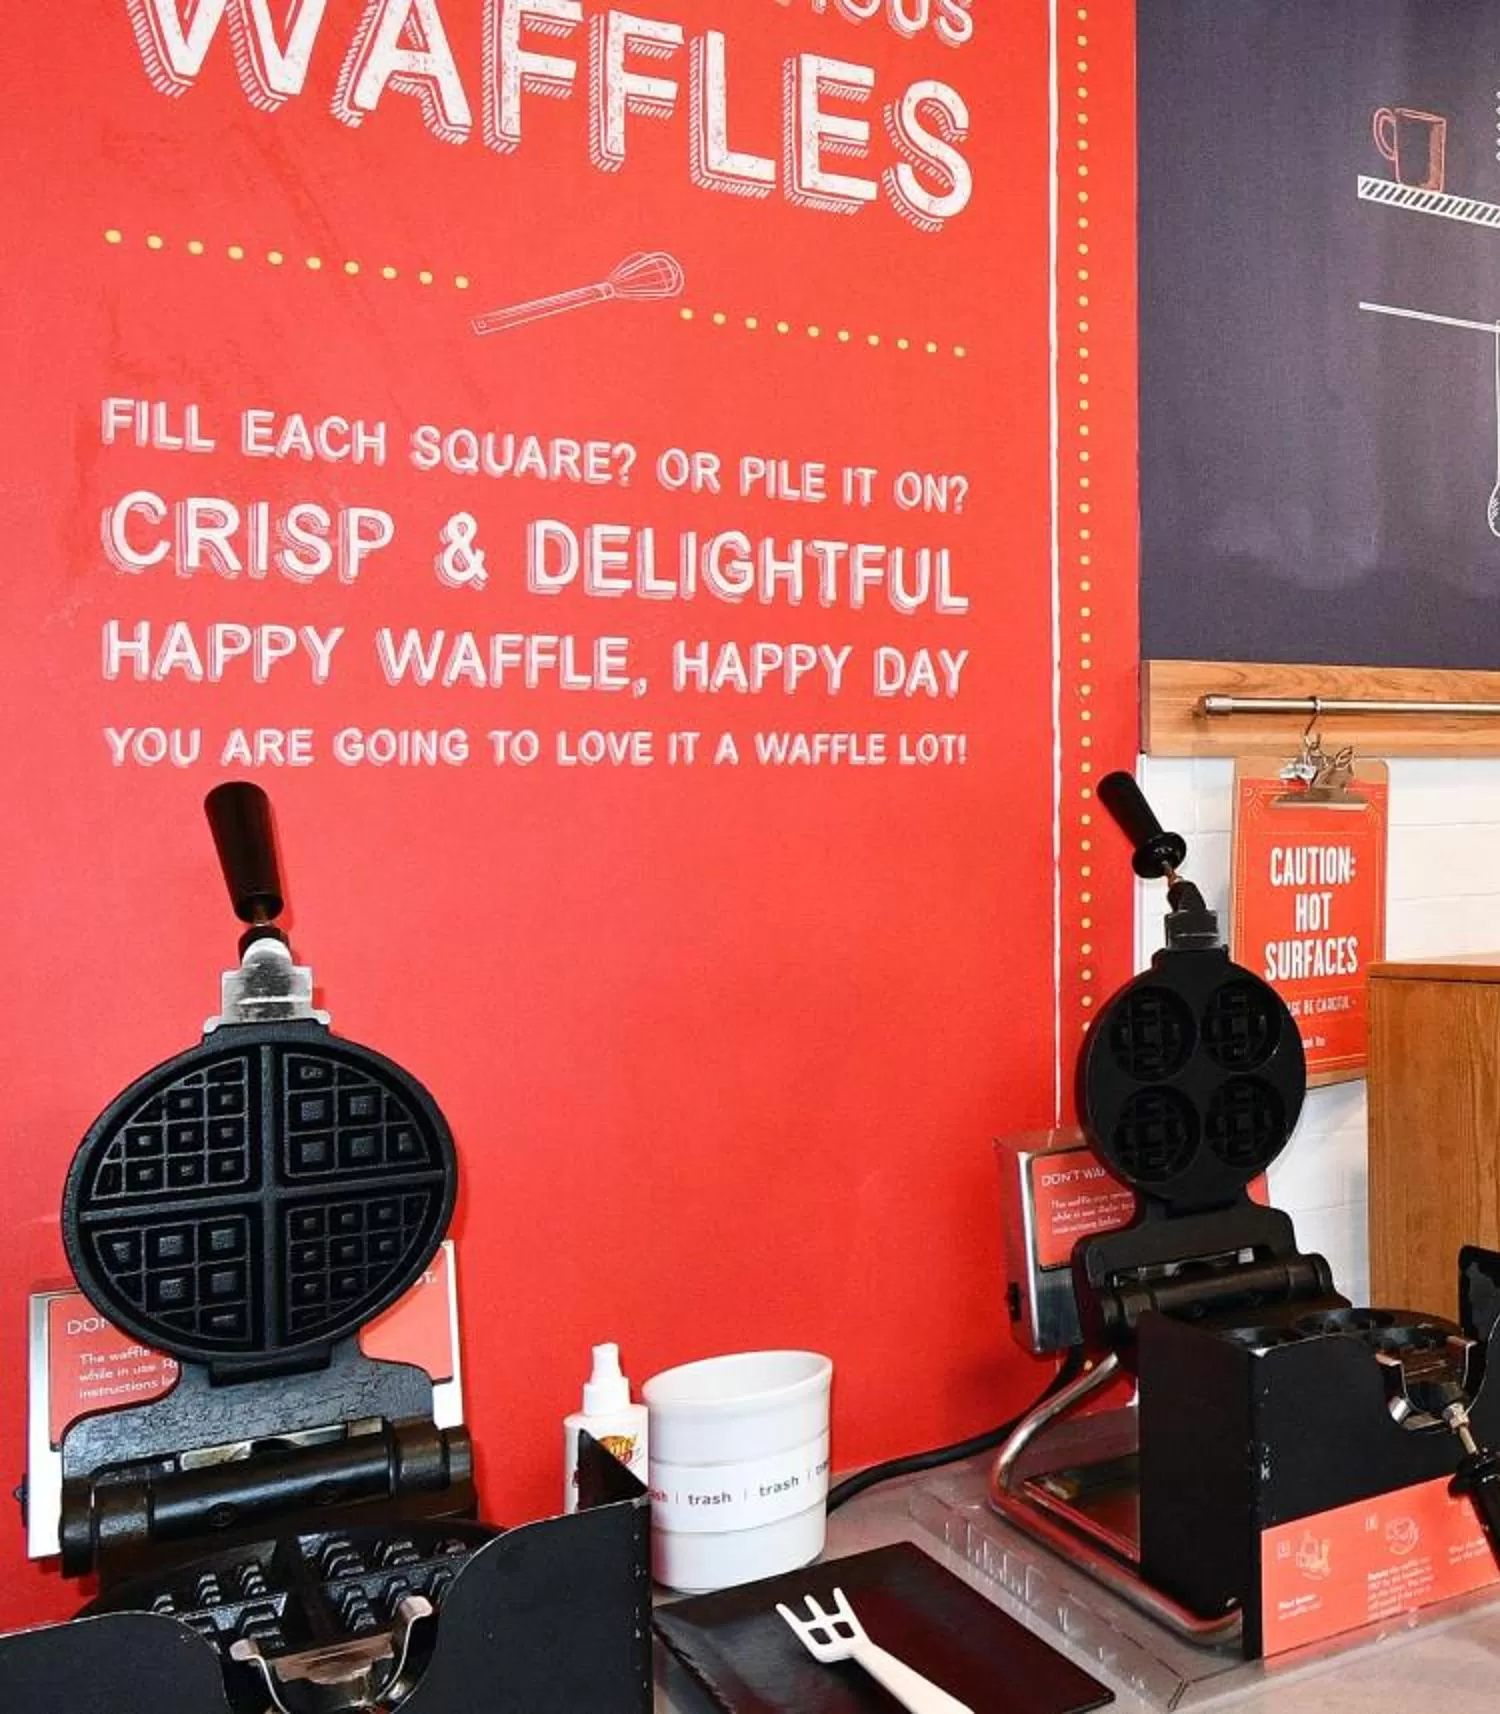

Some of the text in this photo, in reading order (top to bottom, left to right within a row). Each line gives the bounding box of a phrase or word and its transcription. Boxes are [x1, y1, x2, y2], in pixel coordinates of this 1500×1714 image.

[128, 0, 974, 232] WAFFLES
[102, 396, 970, 514] FILL EACH SQUARE? OR PILE IT ON?
[101, 489, 970, 615] CRISP & DELIGHTFUL
[102, 617, 970, 698] HAPPY WAFFLE, HAPPY DAY
[103, 726, 968, 767] YOU ARE GOING TO LOVE IT A WAFFLE LOT!
[1270, 847, 1356, 887] CAUTION:
[1295, 892, 1332, 933] HOT
[1264, 937, 1358, 982] SURFACES
[80, 1345, 151, 1365] The waffle
[80, 1369, 113, 1382] while
[117, 1366, 129, 1377] in
[80, 1379, 158, 1400] instructions
[688, 1491, 732, 1506] trash
[759, 1475, 800, 1498] trash
